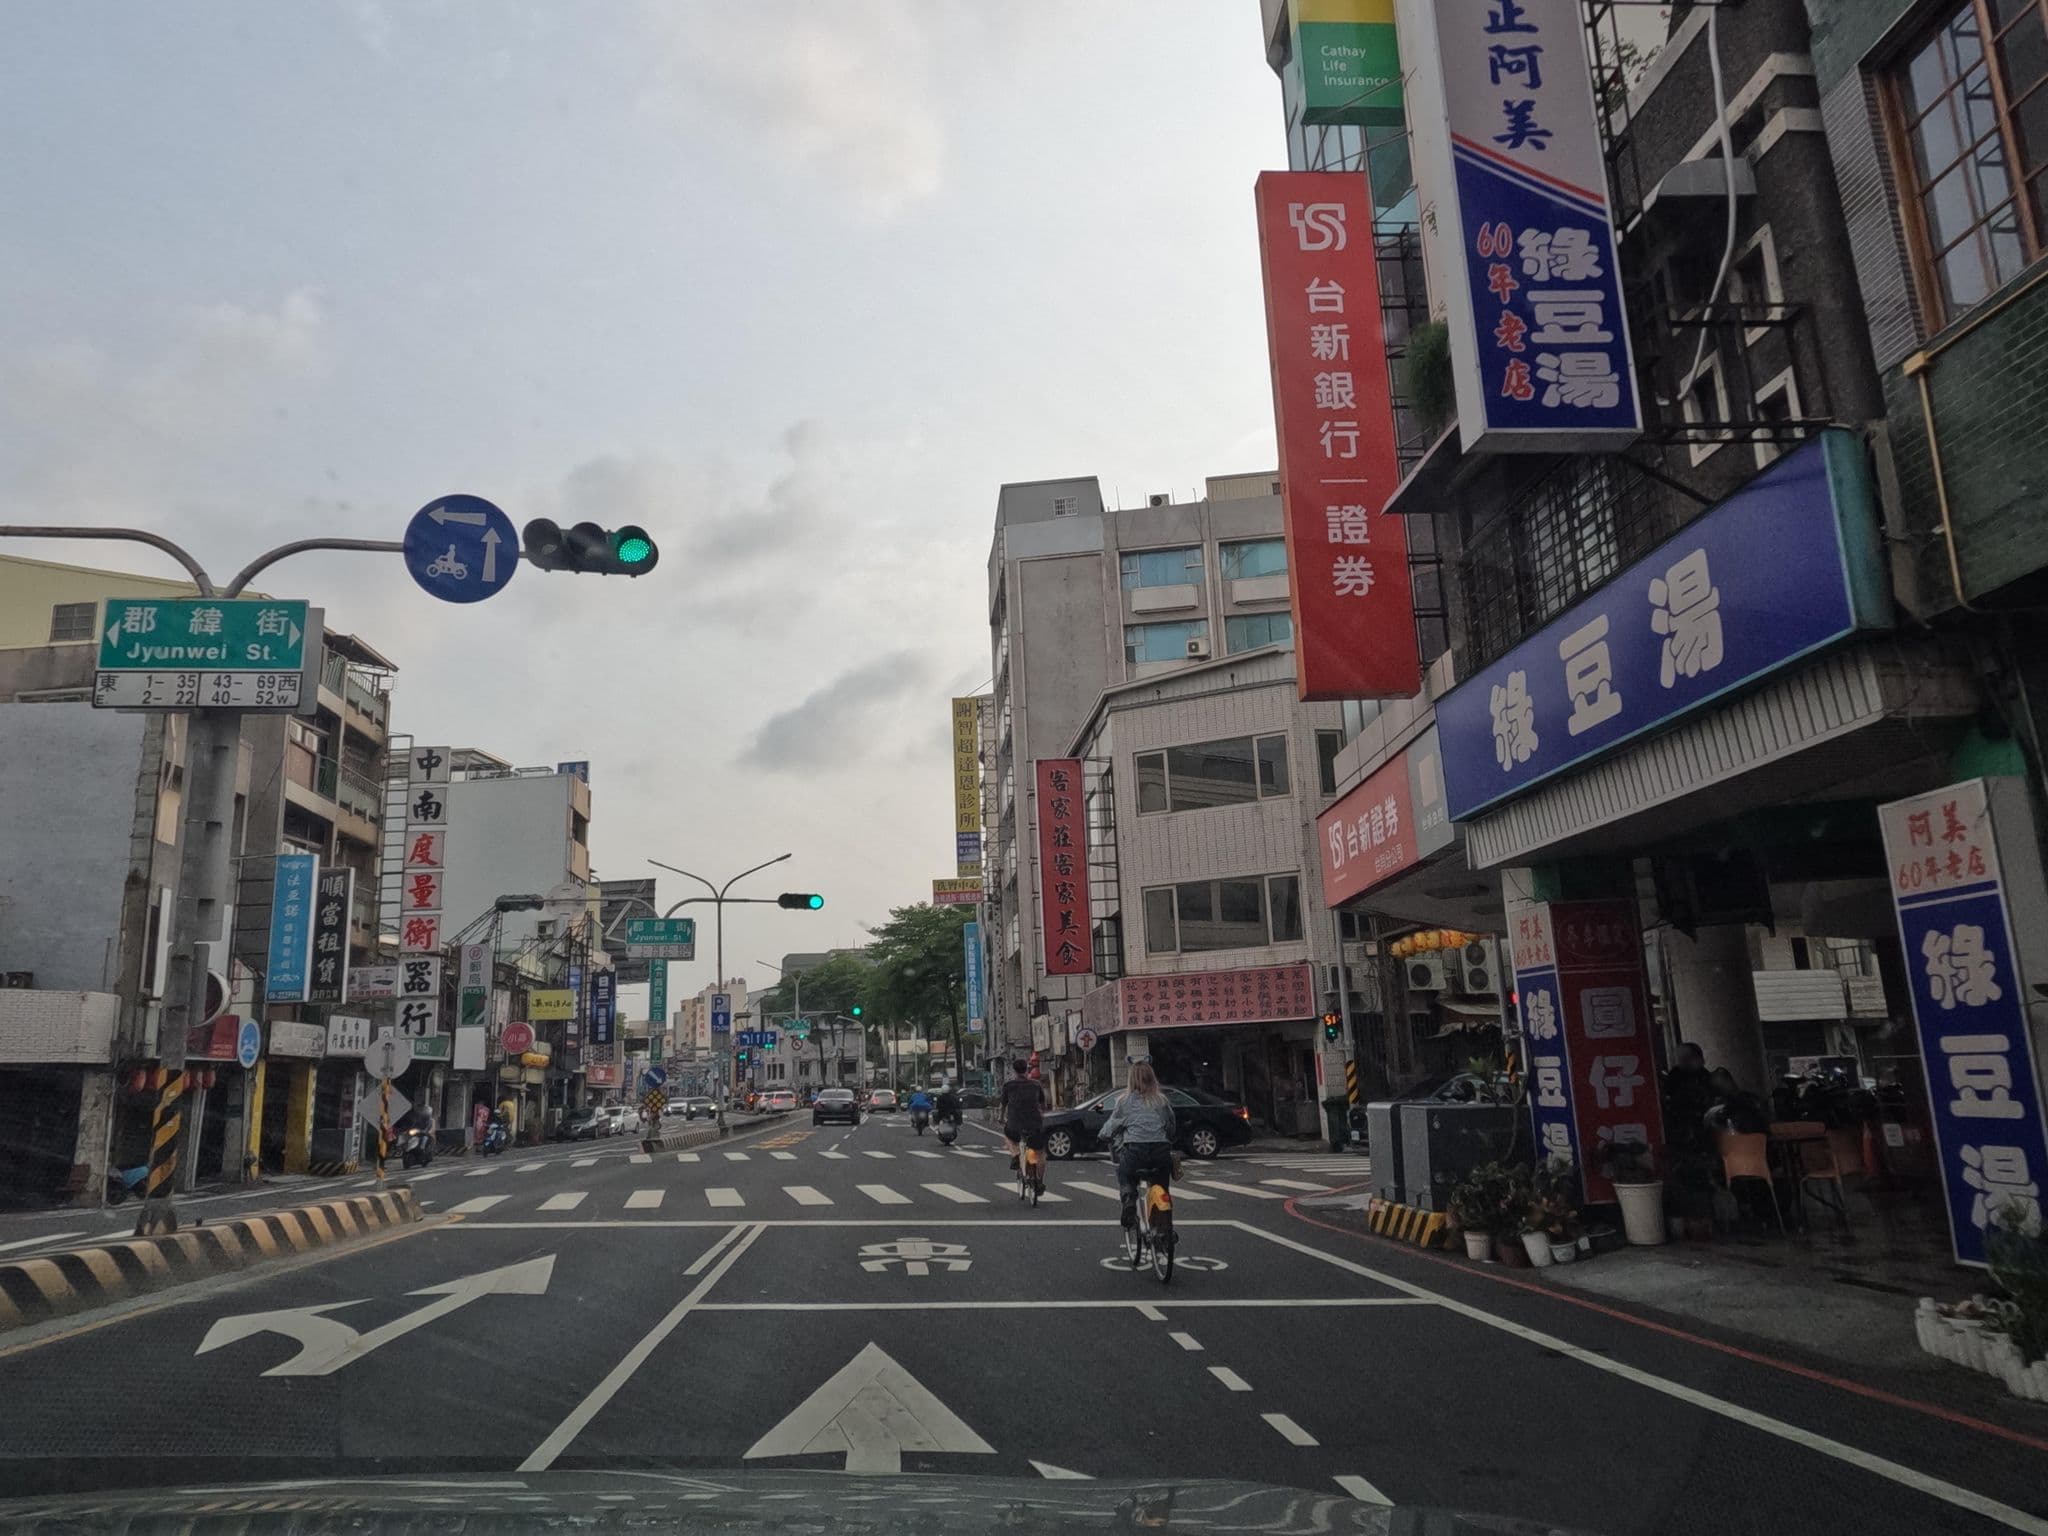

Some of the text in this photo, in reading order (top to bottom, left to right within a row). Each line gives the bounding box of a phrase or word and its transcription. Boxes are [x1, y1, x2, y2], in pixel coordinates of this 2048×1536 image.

[1320, 45, 1366, 59] Cathay
[1322, 60, 1347, 72] Life
[1324, 75, 1388, 87] Insurance
[1477, 222, 1535, 401] 60年老店
[1517, 228, 1620, 409] 綠豆湯
[122, 606, 289, 636] 郡緯街
[126, 643, 277, 662] Jyunwei St.
[1489, 548, 1724, 772] 綠豆湯
[99, 674, 119, 692] 東
[278, 675, 298, 692] 西
[1347, 794, 1398, 858] 台新證券
[1907, 801, 1967, 847] 阿美
[1898, 847, 1986, 890] 60年老店
[400, 749, 442, 1038] 中南度量衡器行
[1519, 916, 1543, 940] 阿美
[714, 997, 724, 1010] P
[1525, 988, 1573, 1172] 綠豆湯
[1921, 924, 2042, 1238] 綠豆湯
